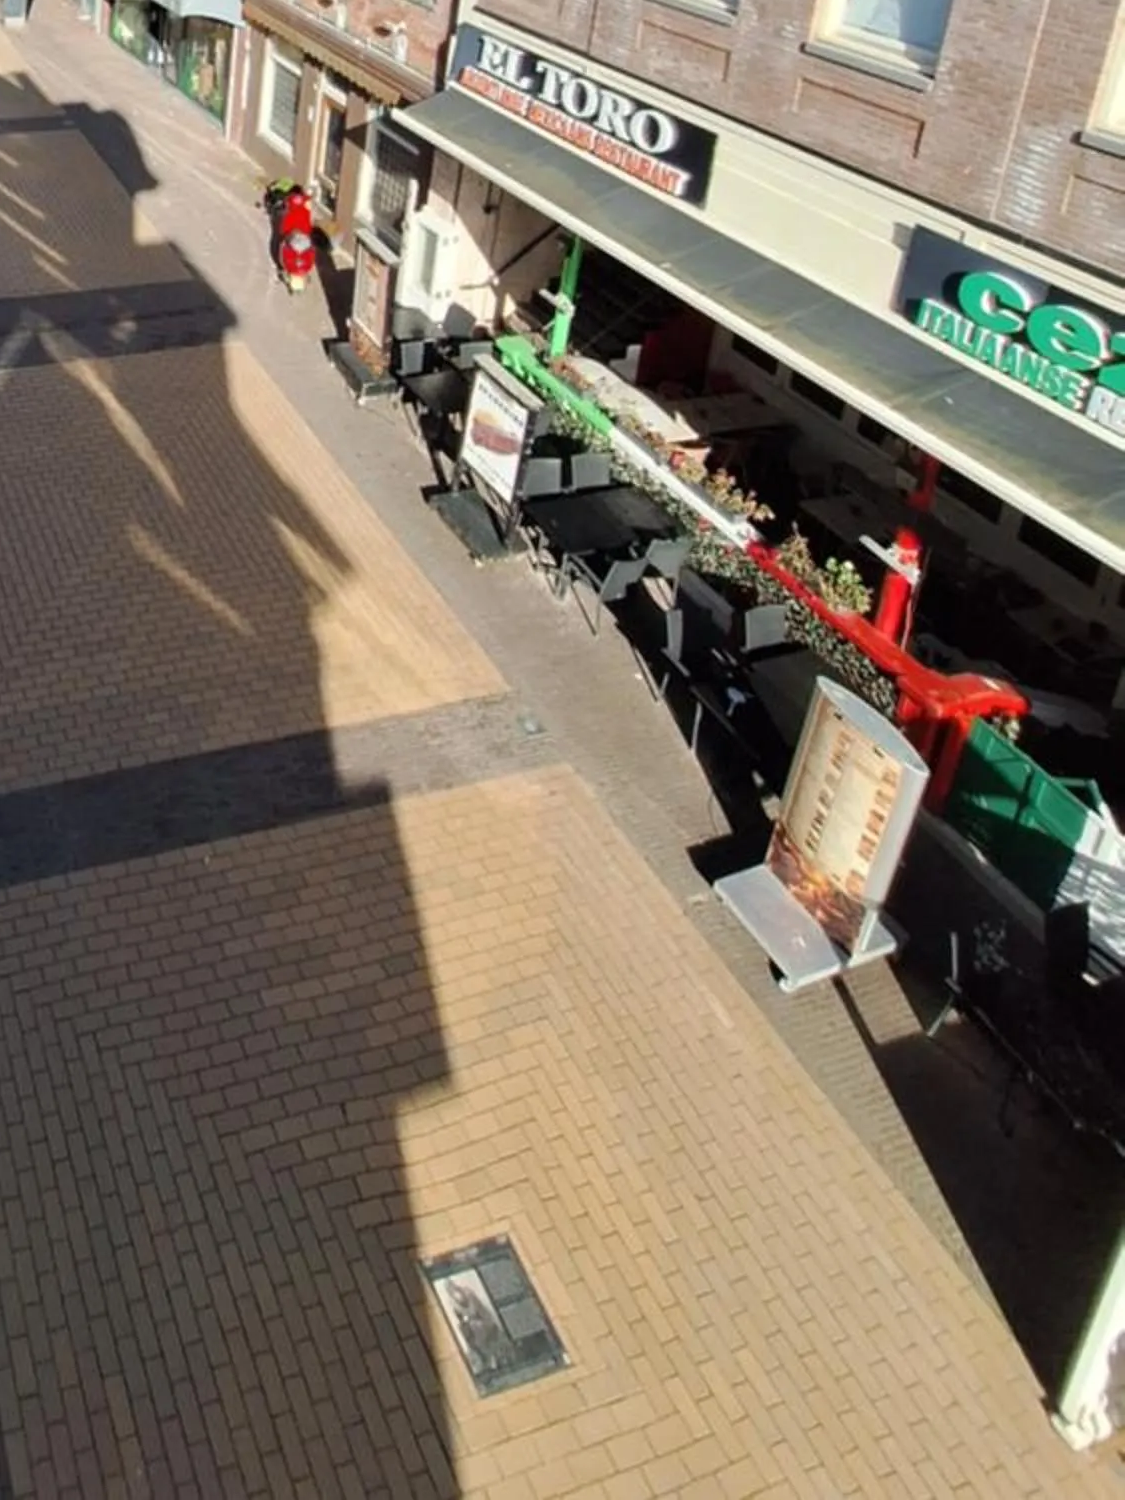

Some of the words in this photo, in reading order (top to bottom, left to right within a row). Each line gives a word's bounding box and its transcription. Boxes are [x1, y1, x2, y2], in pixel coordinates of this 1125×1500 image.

[477, 35, 532, 90] EL
[535, 60, 678, 154] TORO
[917, 298, 1092, 412] ITALIAANSE
